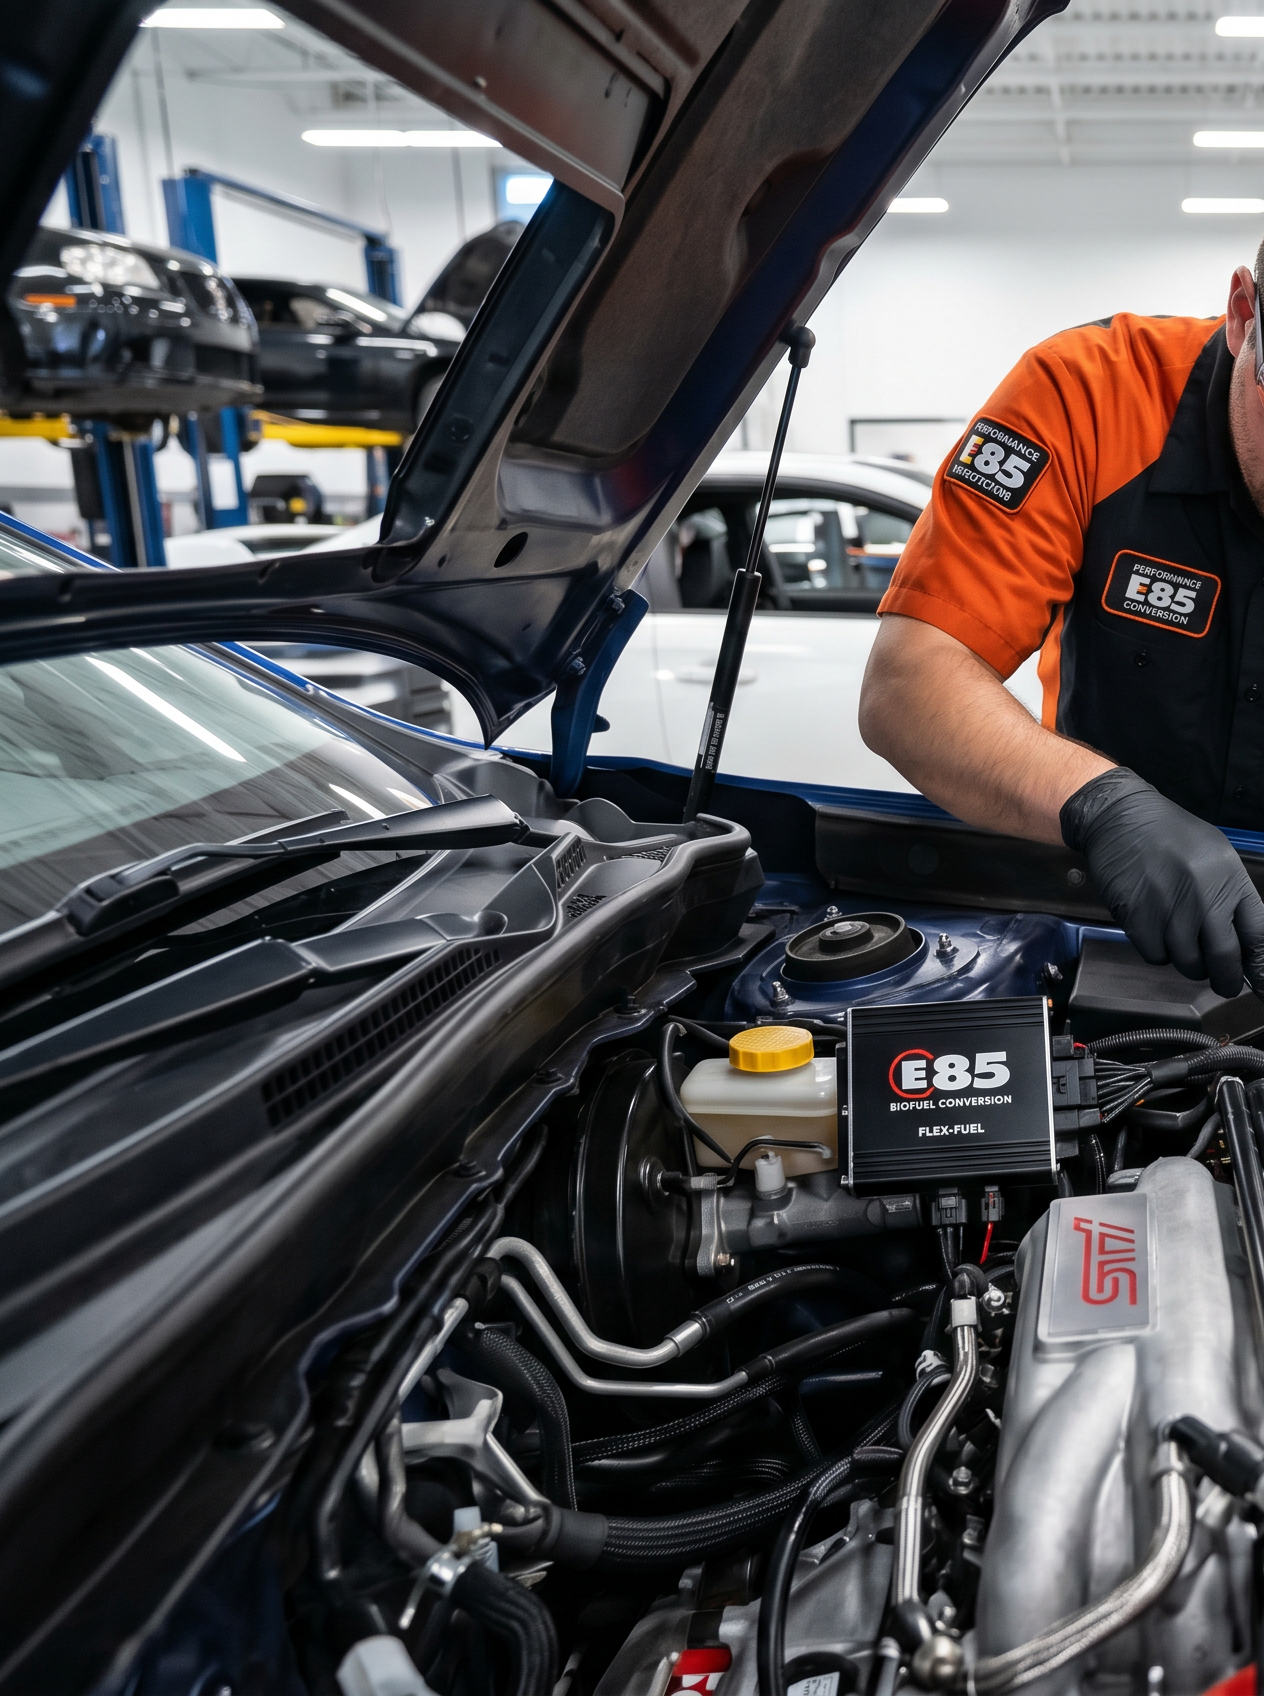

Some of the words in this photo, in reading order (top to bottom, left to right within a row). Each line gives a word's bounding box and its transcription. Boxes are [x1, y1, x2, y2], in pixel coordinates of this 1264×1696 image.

[1125, 573, 1197, 614] E85
[1123, 600, 1189, 625] CONVERSION
[901, 1051, 1011, 1091] E85
[890, 1099, 936, 1112] BIOFUEL
[938, 1095, 1012, 1109] CONVERSION
[918, 1123, 985, 1137] FLEX-FUEL
